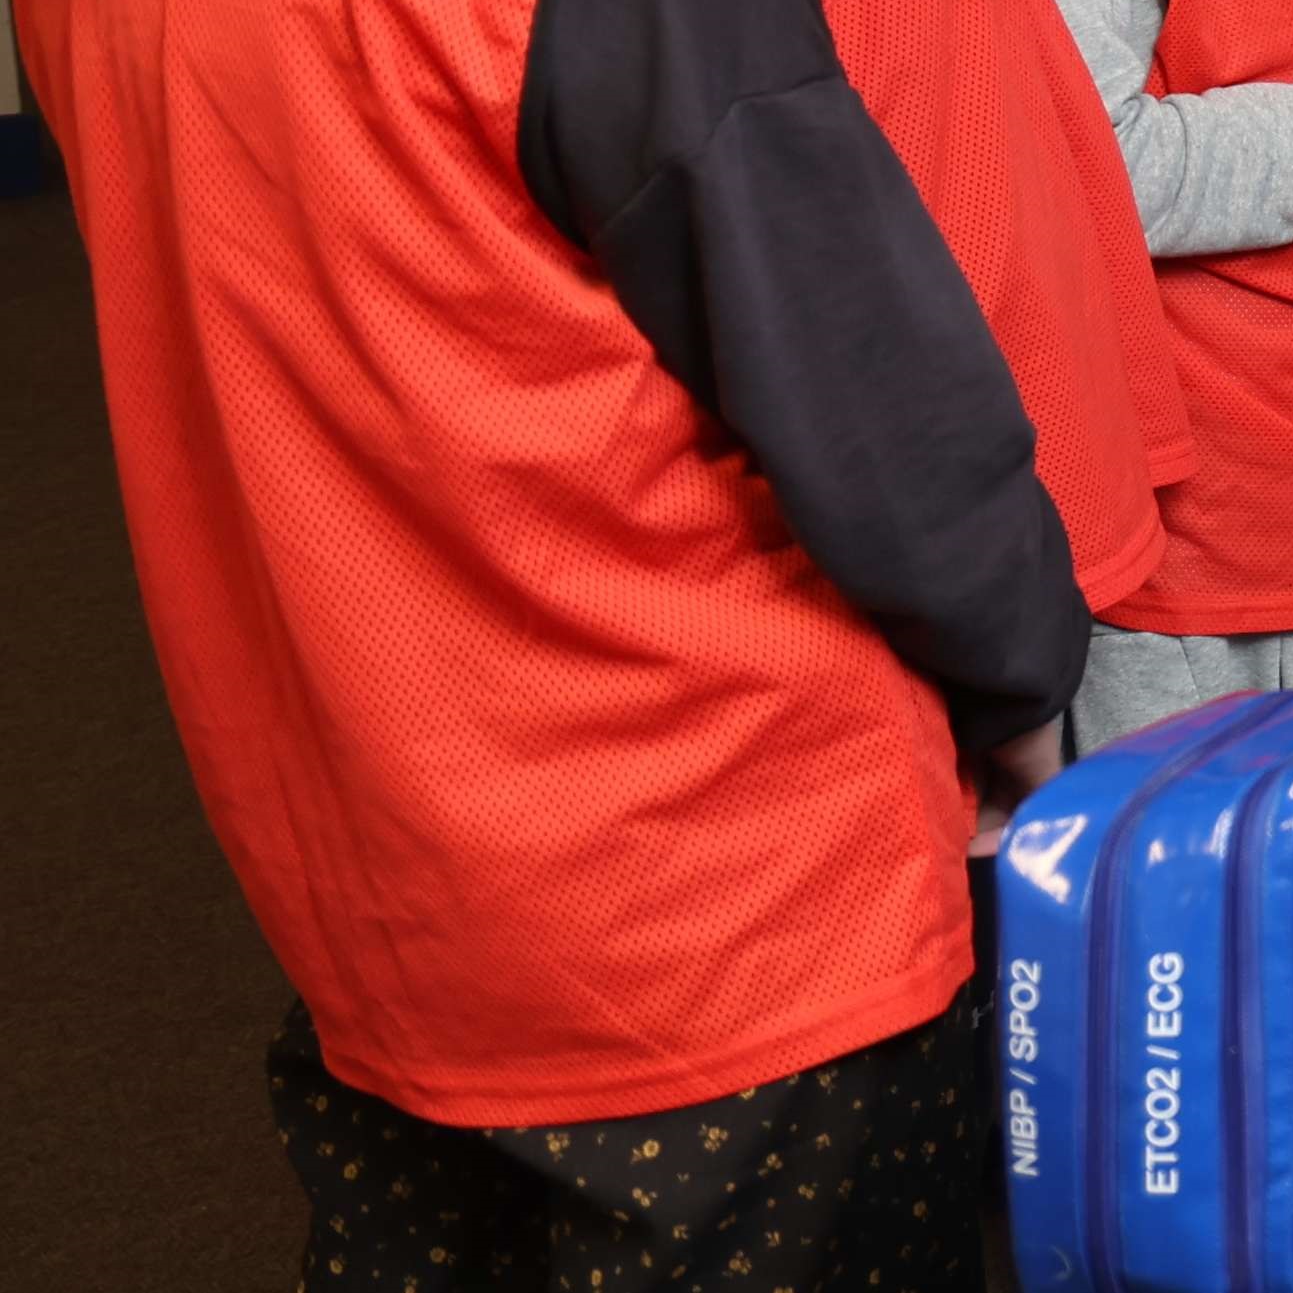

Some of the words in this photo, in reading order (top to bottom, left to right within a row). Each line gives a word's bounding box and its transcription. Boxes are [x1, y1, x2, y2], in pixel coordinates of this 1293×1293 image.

[1009, 958, 1042, 1062] SPO2
[1147, 952, 1184, 1037] ECG
[1009, 1068, 1037, 1085] /
[1146, 1045, 1182, 1060] /
[1010, 1089, 1039, 1176] NIBP
[1145, 1068, 1181, 1195] ETCO2
